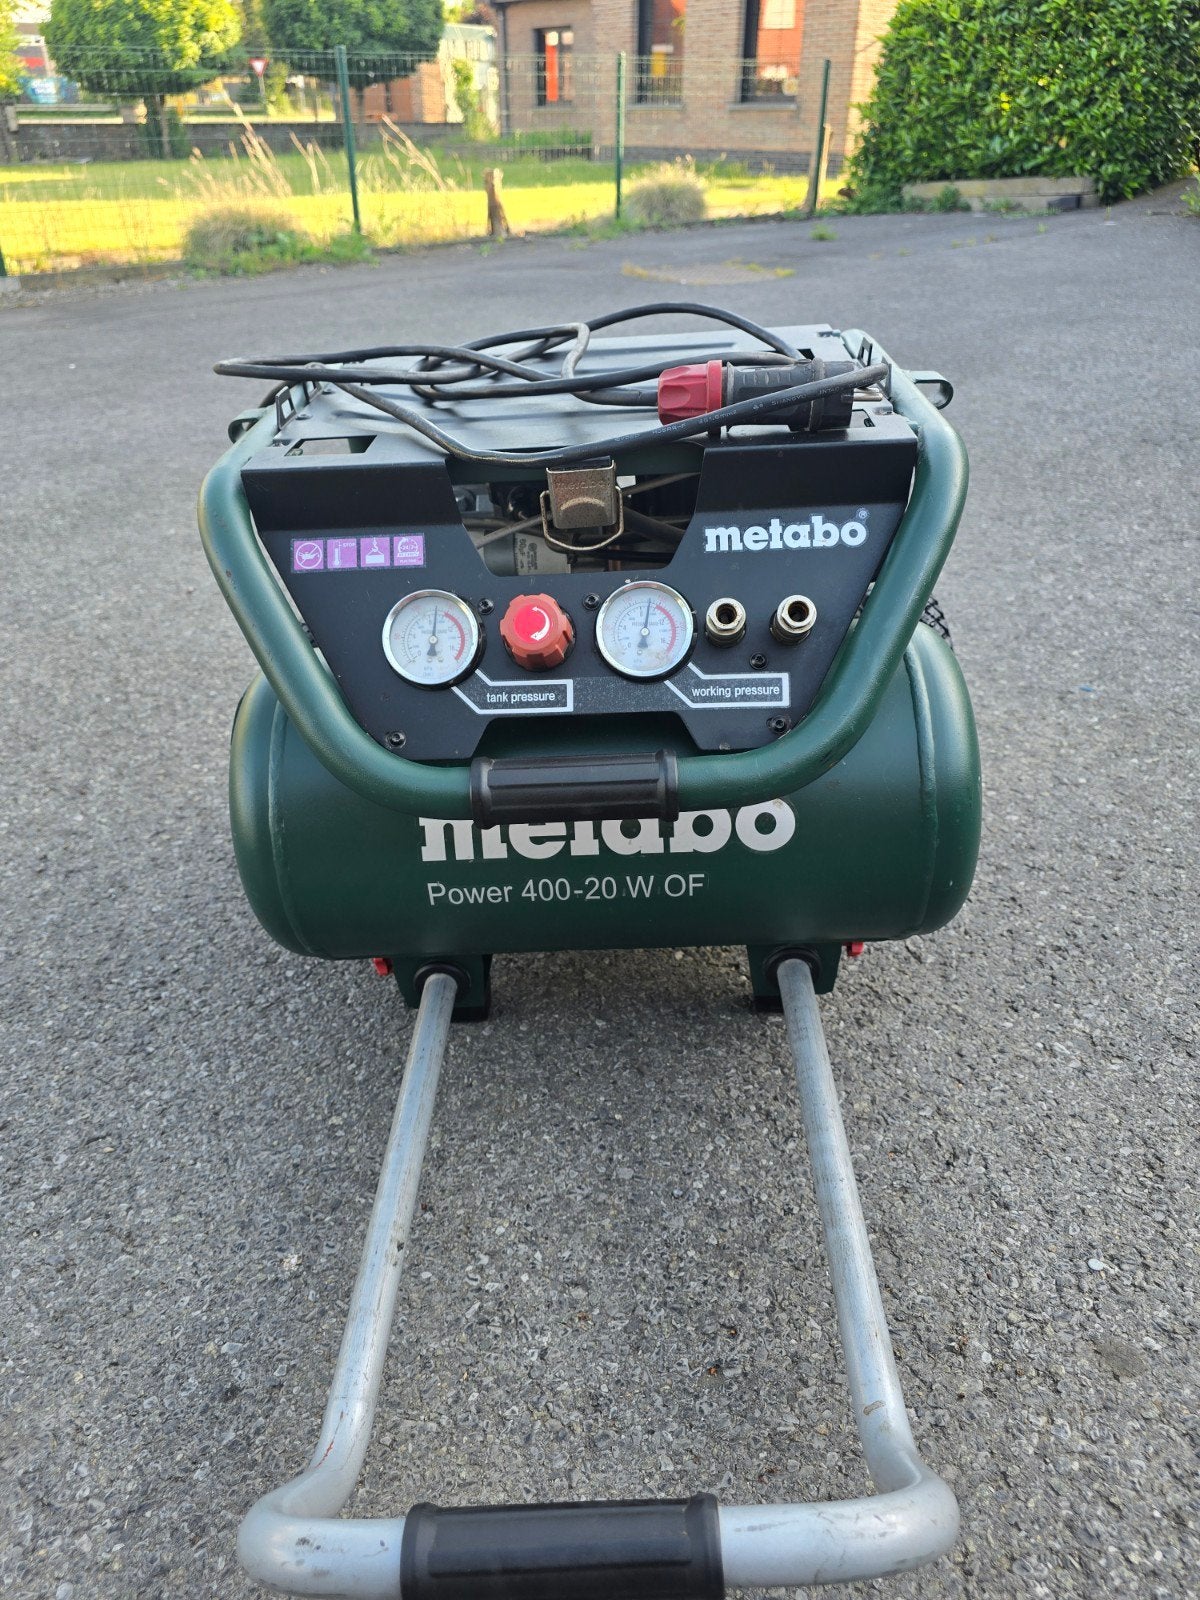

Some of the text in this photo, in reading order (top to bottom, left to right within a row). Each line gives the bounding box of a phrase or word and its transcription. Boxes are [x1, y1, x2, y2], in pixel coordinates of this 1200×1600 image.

[704, 515, 867, 552] metabo
[486, 691, 556, 704] tank pressure
[691, 684, 780, 698] working pressure
[426, 873, 706, 906] Power 400-20 W OF
